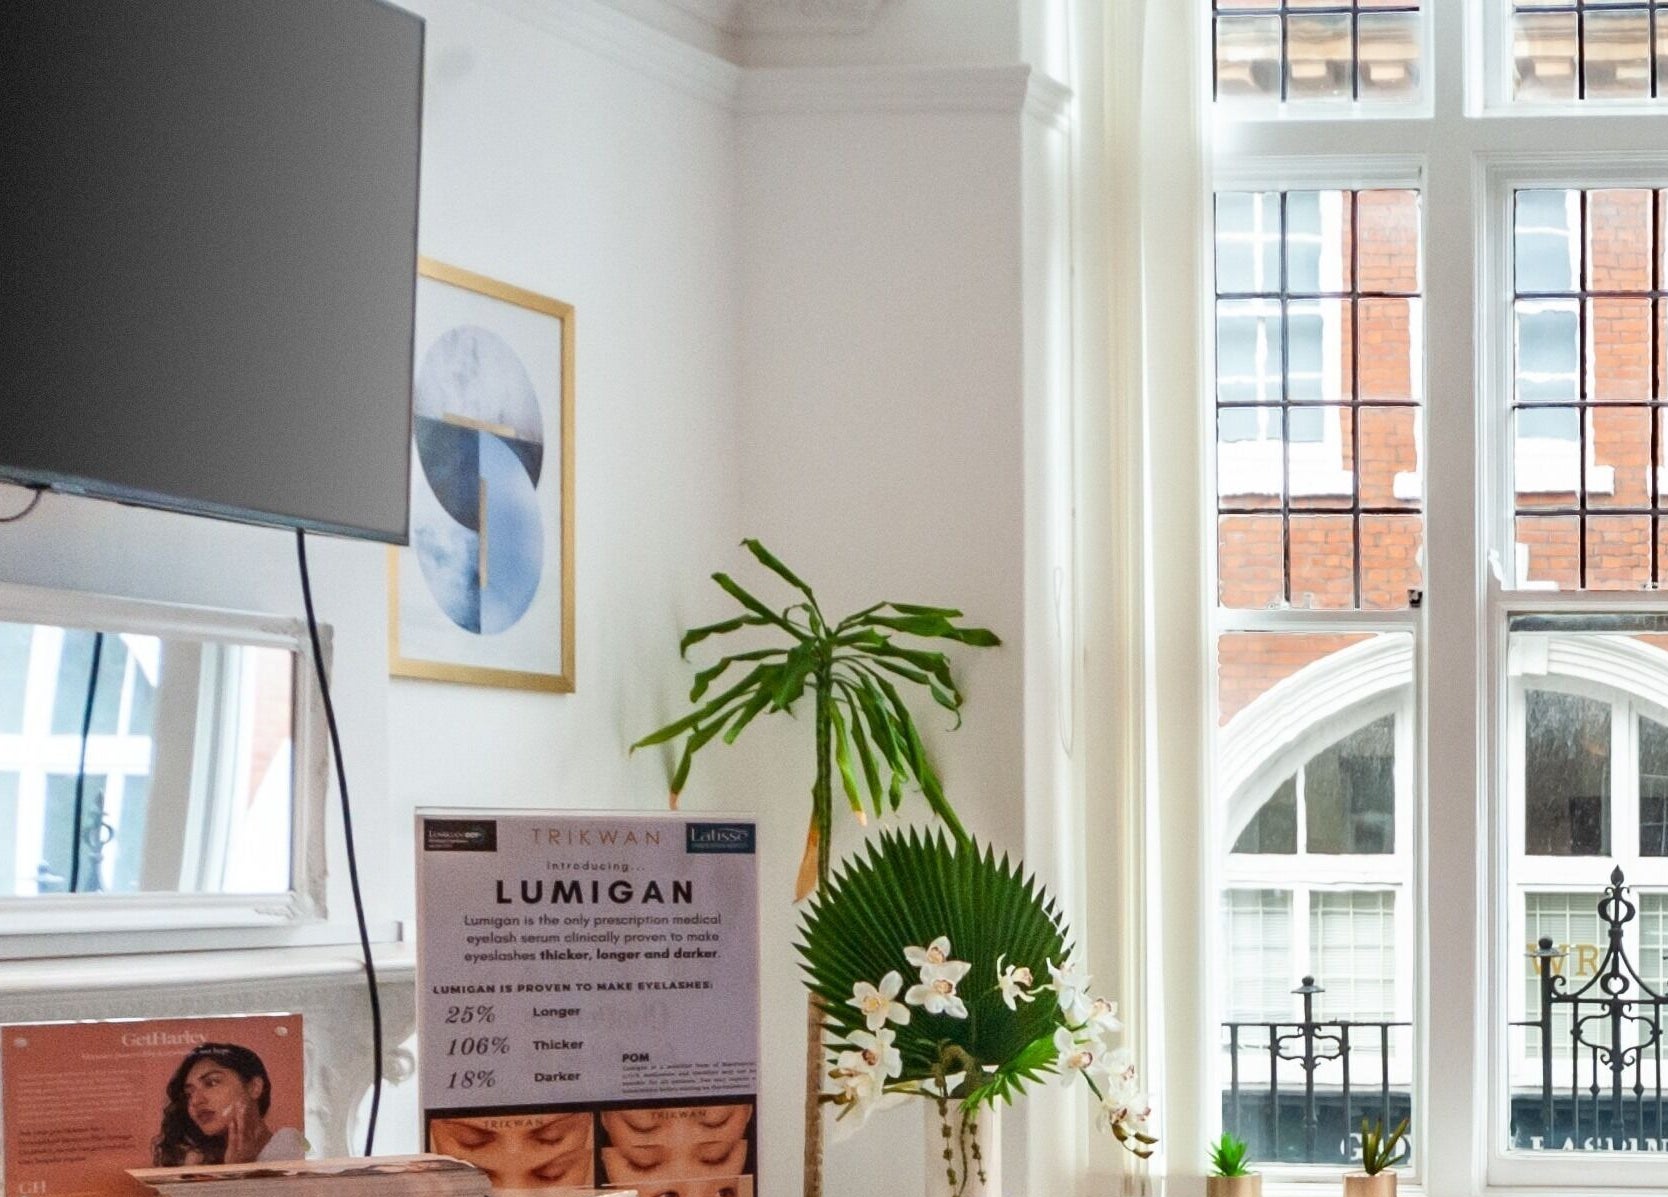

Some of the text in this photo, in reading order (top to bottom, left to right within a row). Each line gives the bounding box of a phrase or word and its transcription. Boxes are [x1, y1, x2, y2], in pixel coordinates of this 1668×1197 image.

[532, 827, 661, 846] TRIKWAN
[496, 879, 693, 904] LUMIGAN
[464, 912, 722, 929] Lumigan is the only prescription medical
[466, 929, 720, 946] eyelash serum clinically proven to make
[539, 947, 593, 961] thicker,
[596, 947, 641, 963] longer
[644, 946, 670, 959] and
[433, 984, 496, 995] LUMIGAN
[500, 983, 513, 993] IS
[517, 983, 571, 993] PROVEN
[575, 982, 593, 992] TO
[597, 981, 633, 991] MAKE
[445, 1005, 582, 1025] 25% Longer
[121, 1029, 210, 1049] GetHarley
[447, 1035, 585, 1057] 106% Thicker
[622, 1052, 650, 1063] POM
[446, 1068, 581, 1090] 18% Darker
